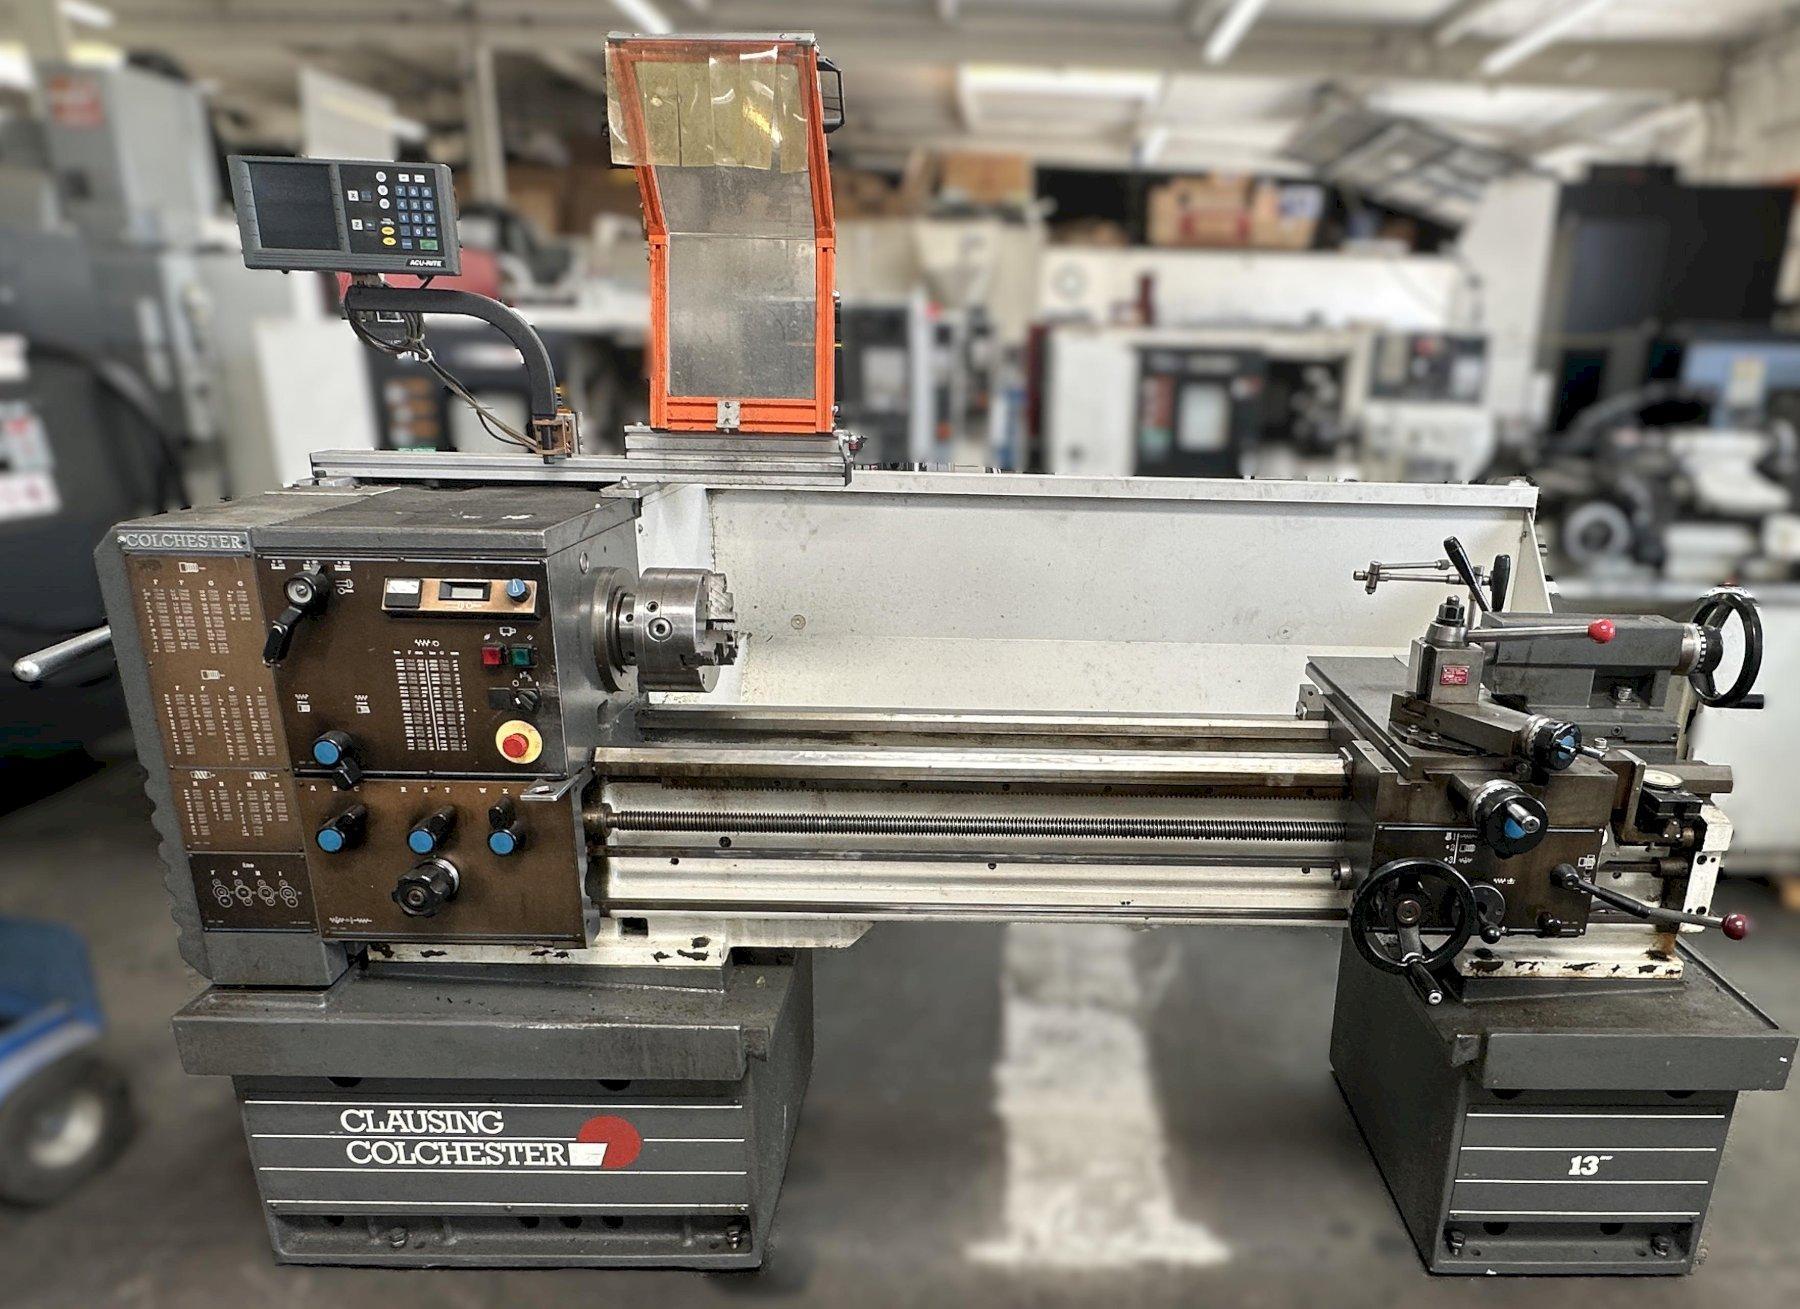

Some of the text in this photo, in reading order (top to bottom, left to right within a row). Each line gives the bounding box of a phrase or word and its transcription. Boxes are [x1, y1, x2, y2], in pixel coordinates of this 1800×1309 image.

[410, 259, 442, 267] ACU-RITE
[126, 533, 243, 549] COLCHESTER
[340, 1109, 504, 1134] CLAUSING
[346, 1140, 569, 1166] COLCHESTER
